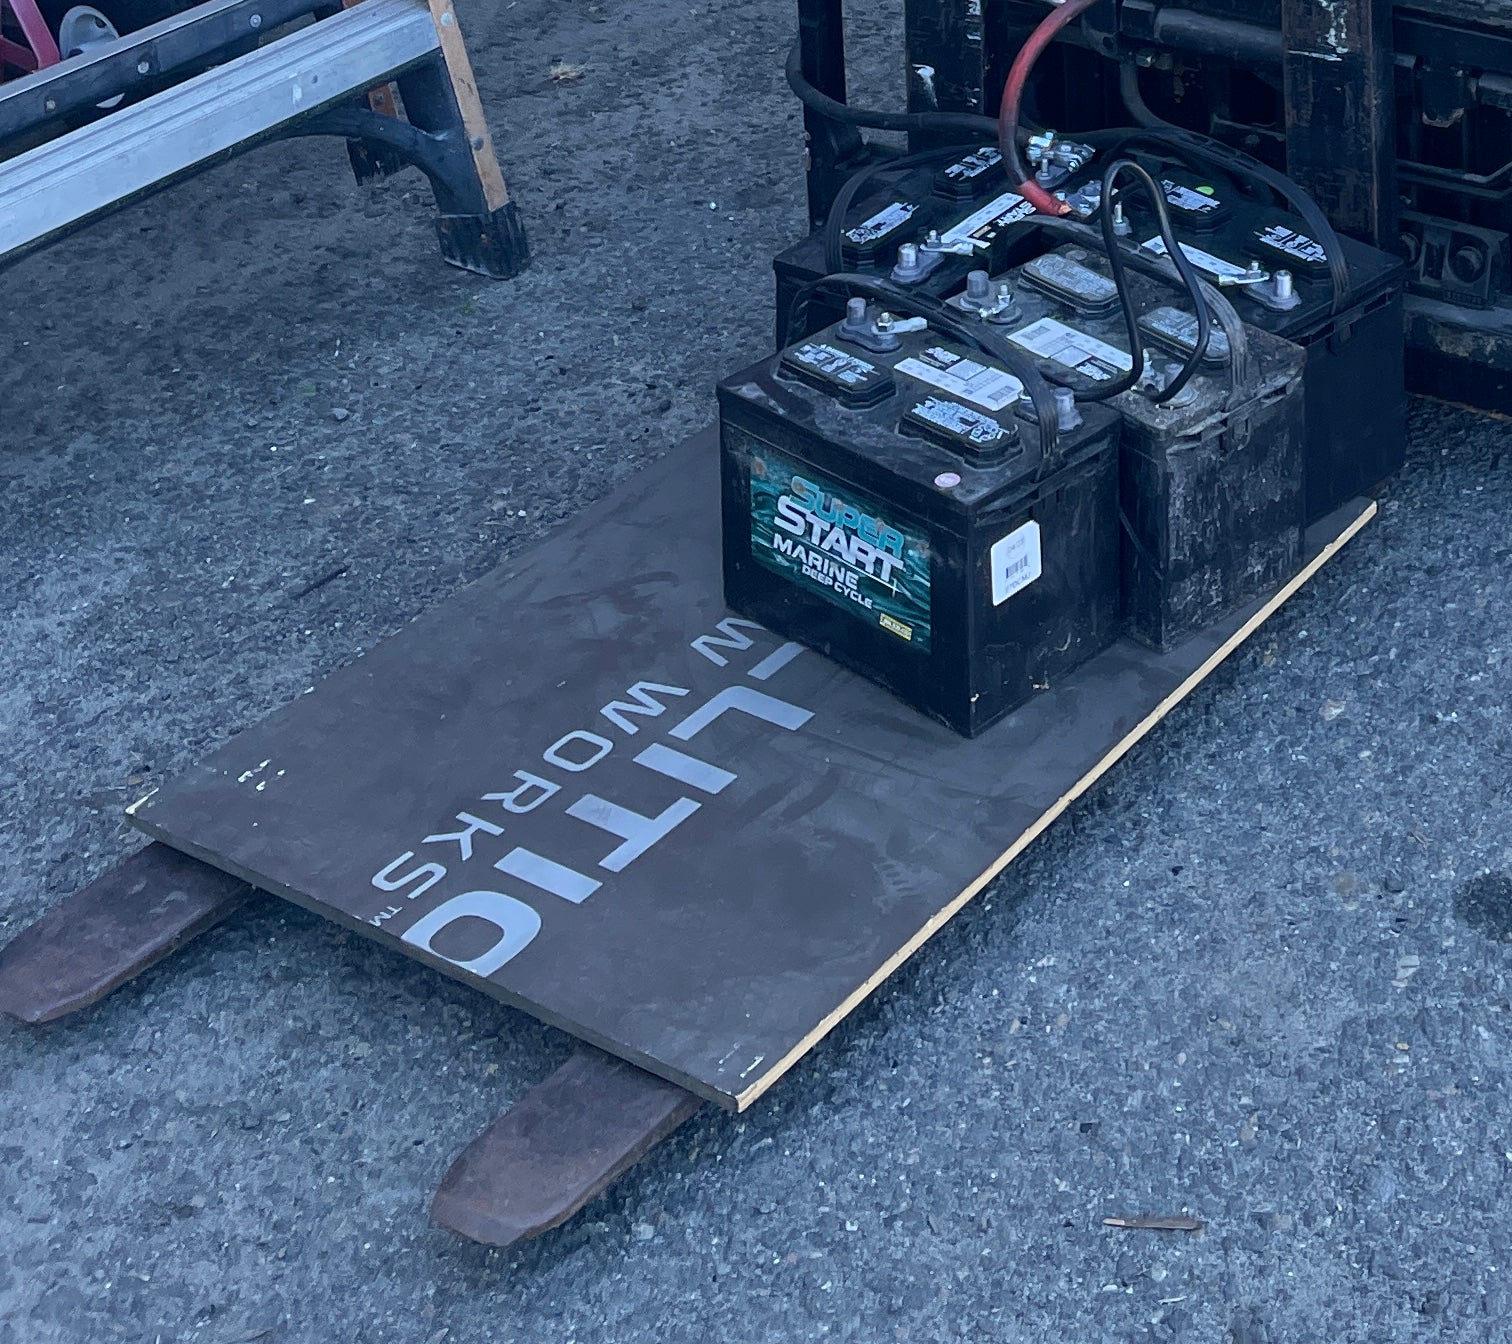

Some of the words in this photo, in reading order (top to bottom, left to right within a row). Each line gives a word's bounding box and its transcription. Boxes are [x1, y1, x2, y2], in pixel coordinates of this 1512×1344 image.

[773, 495, 905, 583] START
[791, 475, 905, 559] SUPER
[773, 533, 860, 590] MARINE
[801, 563, 834, 587] DEEP
[834, 581, 873, 610] CYCLE
